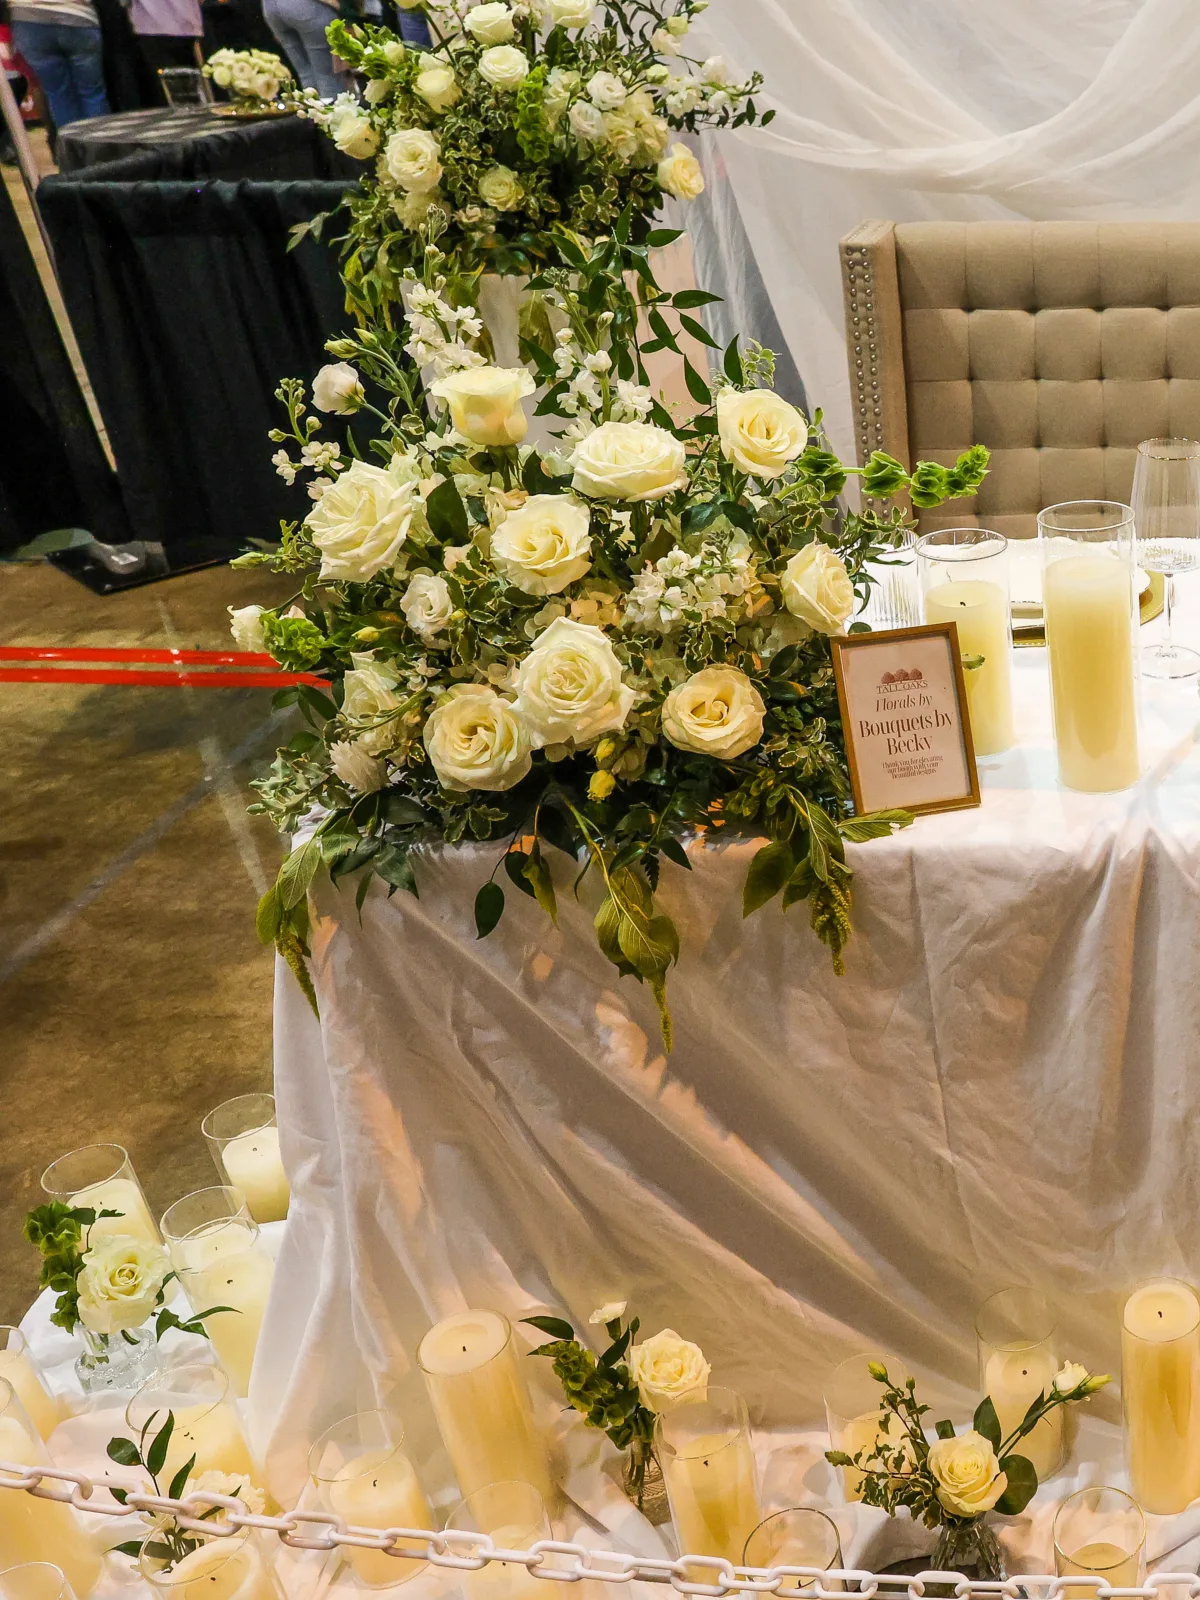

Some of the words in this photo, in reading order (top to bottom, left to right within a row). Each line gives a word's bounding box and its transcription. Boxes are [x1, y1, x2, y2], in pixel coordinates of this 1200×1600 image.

[876, 683, 902, 694] TALL
[902, 680, 928, 691] OAKS
[875, 694, 916, 712] Florals
[919, 693, 933, 707] by
[859, 714, 933, 738] Bouquets
[934, 709, 954, 730] by
[887, 733, 933, 755] Becky
